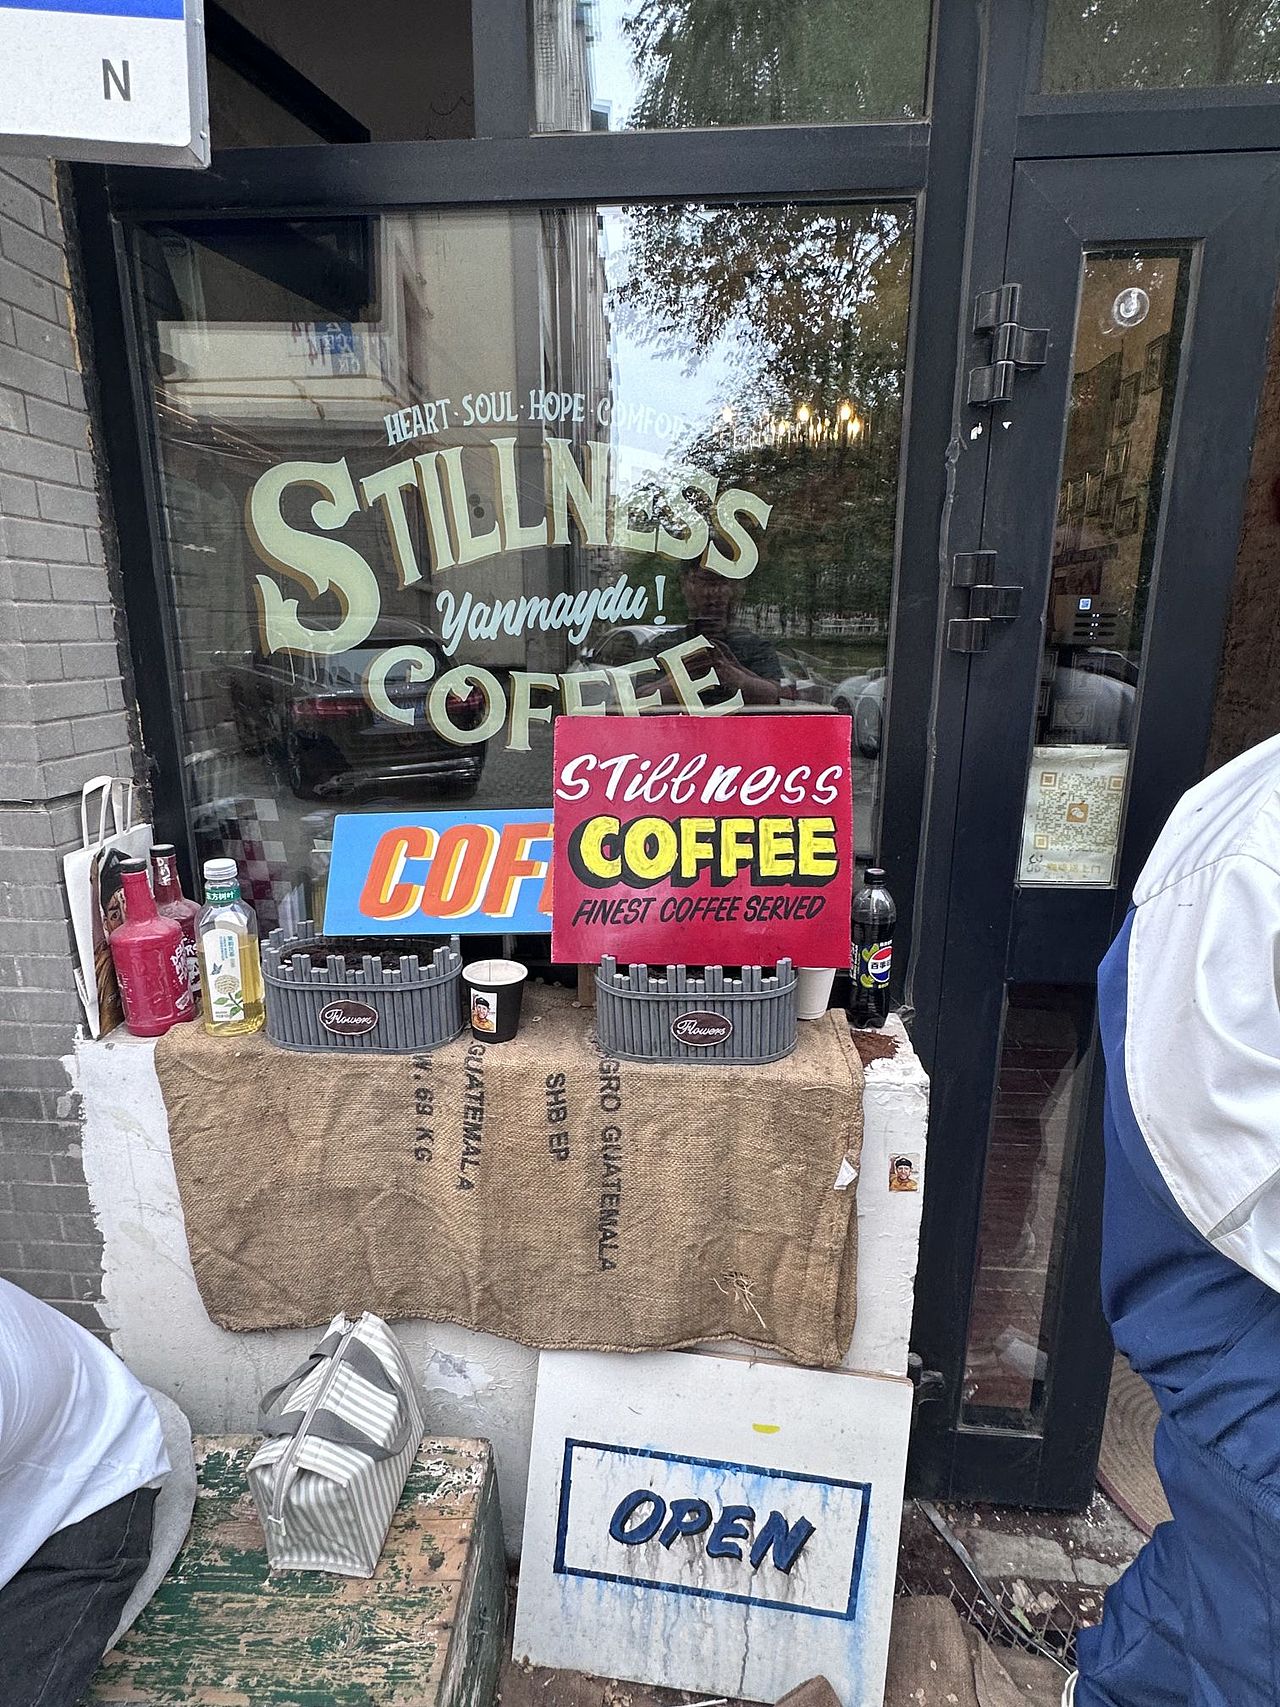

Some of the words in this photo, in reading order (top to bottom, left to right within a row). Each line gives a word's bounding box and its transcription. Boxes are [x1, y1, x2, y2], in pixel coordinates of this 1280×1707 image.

[102, 58, 131, 102] N
[383, 398, 451, 447] HEART
[462, 390, 518, 426] SOUL
[528, 389, 586, 422] HOPE
[246, 436, 774, 657] STILLNESS
[568, 815, 840, 888] COFFEE
[571, 896, 656, 927] FINEST
[660, 895, 739, 923] COFFEE
[743, 894, 827, 923] SERVED
[325, 1009, 372, 1024] Flowers
[676, 1019, 726, 1035] Flowers
[456, 1044, 486, 1191] GUATEMALA
[545, 1072, 568, 1123] SHB
[549, 1131, 571, 1162] EP
[598, 1125, 622, 1272] GUATEMALA
[609, 1489, 817, 1576] OPEN
